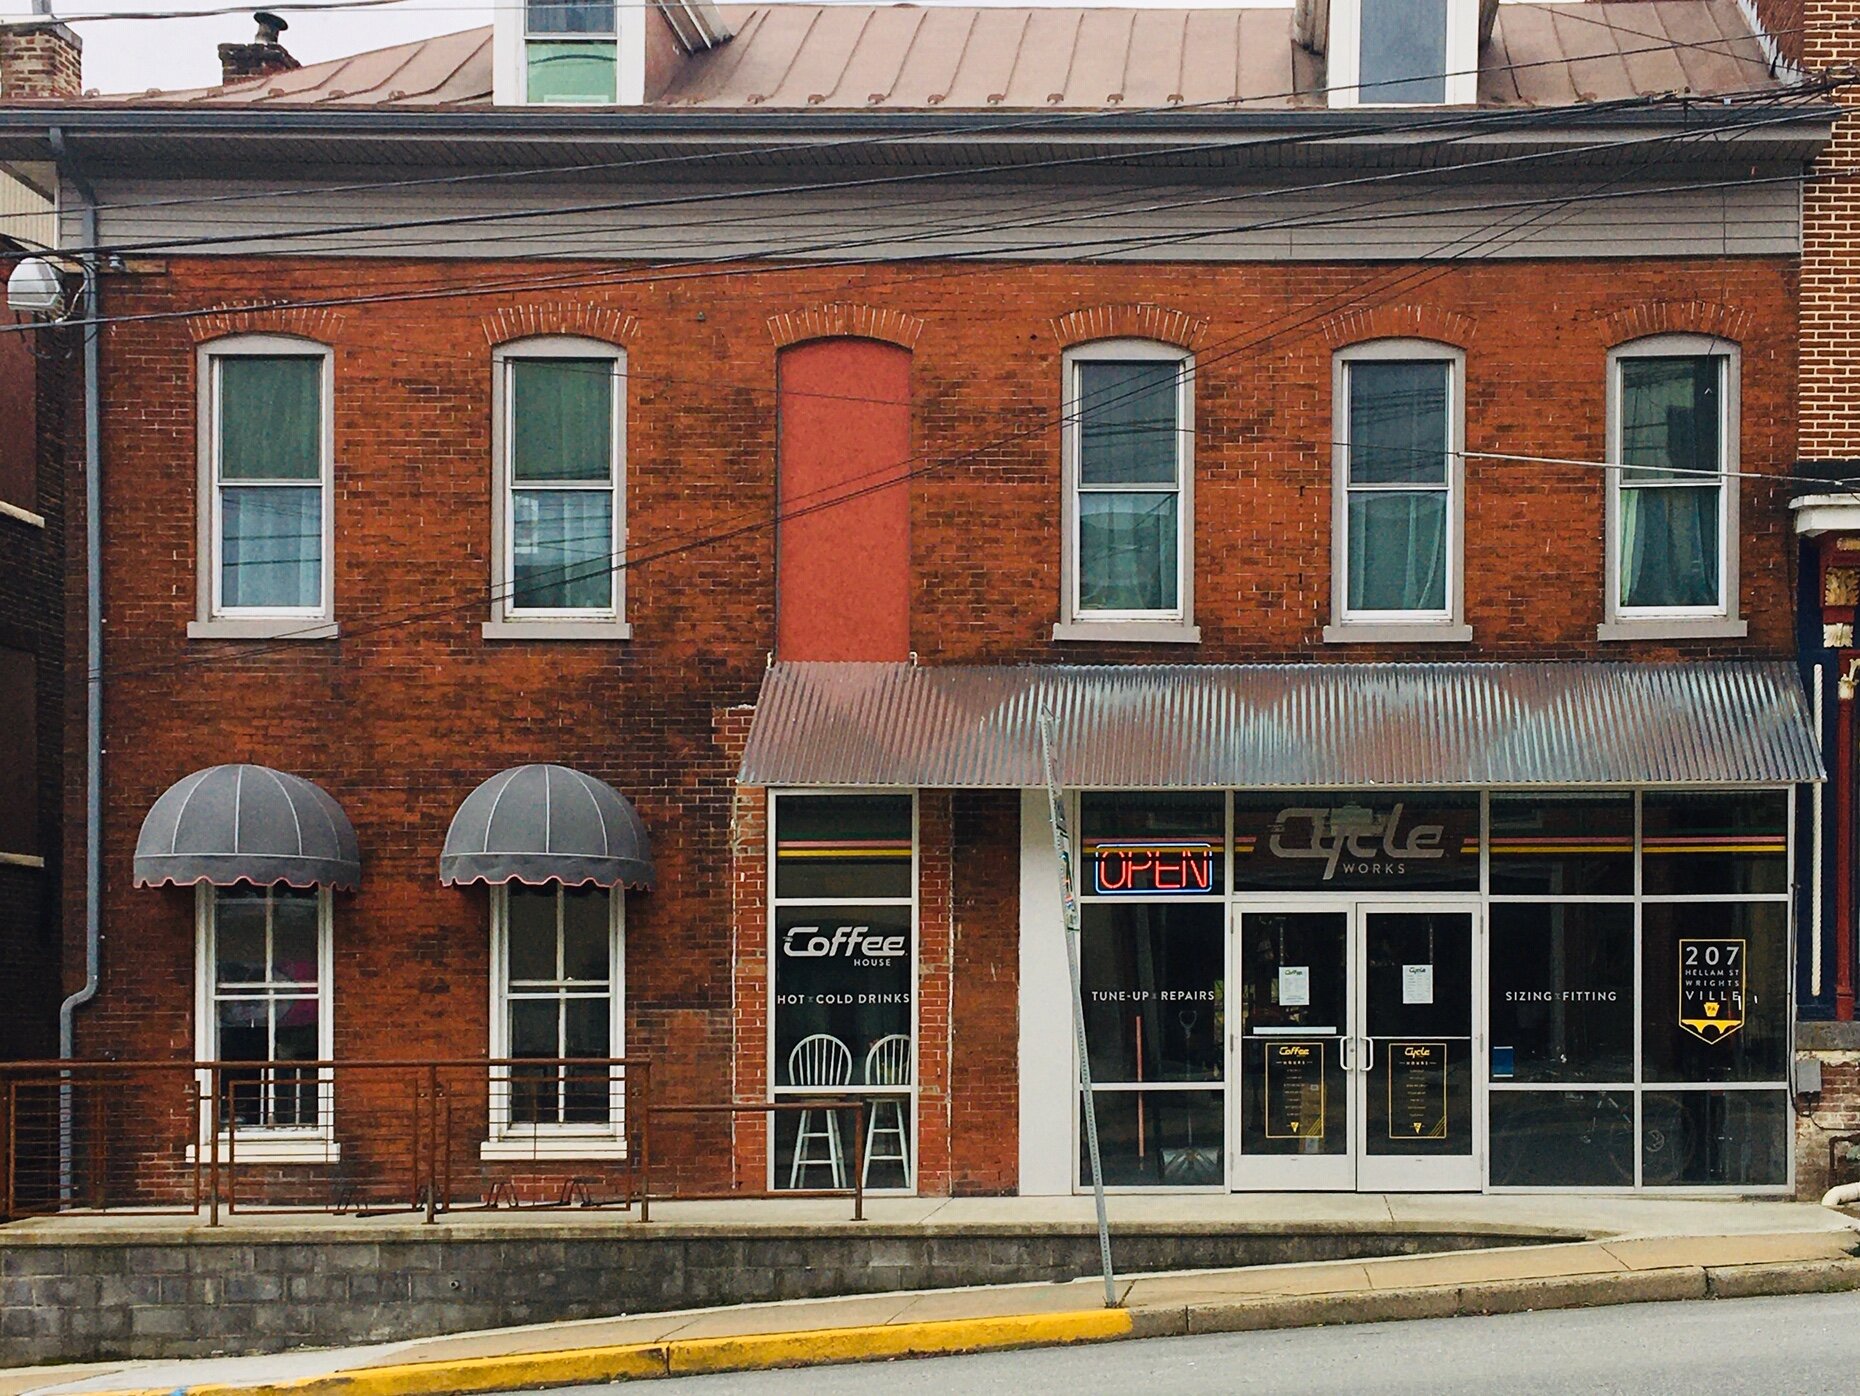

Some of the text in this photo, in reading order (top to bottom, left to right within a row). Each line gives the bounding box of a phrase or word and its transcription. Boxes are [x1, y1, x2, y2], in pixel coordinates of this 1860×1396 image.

[1268, 803, 1444, 880] Cycle
[1100, 849, 1207, 888] OPEN
[1343, 863, 1406, 875] WORKS
[783, 926, 905, 957] Coffee
[1685, 946, 1740, 965] 207
[853, 958, 891, 967] HOUSE
[777, 993, 910, 1004] HOT COLD DRINKS
[1091, 991, 1215, 1001] TUNE-UP REPAIRS
[1505, 991, 1617, 1001] SIZING FITTING
[1685, 991, 1740, 1000] VILLE
[1279, 1047, 1310, 1056] Coffee
[1404, 1047, 1430, 1058] Cycle
